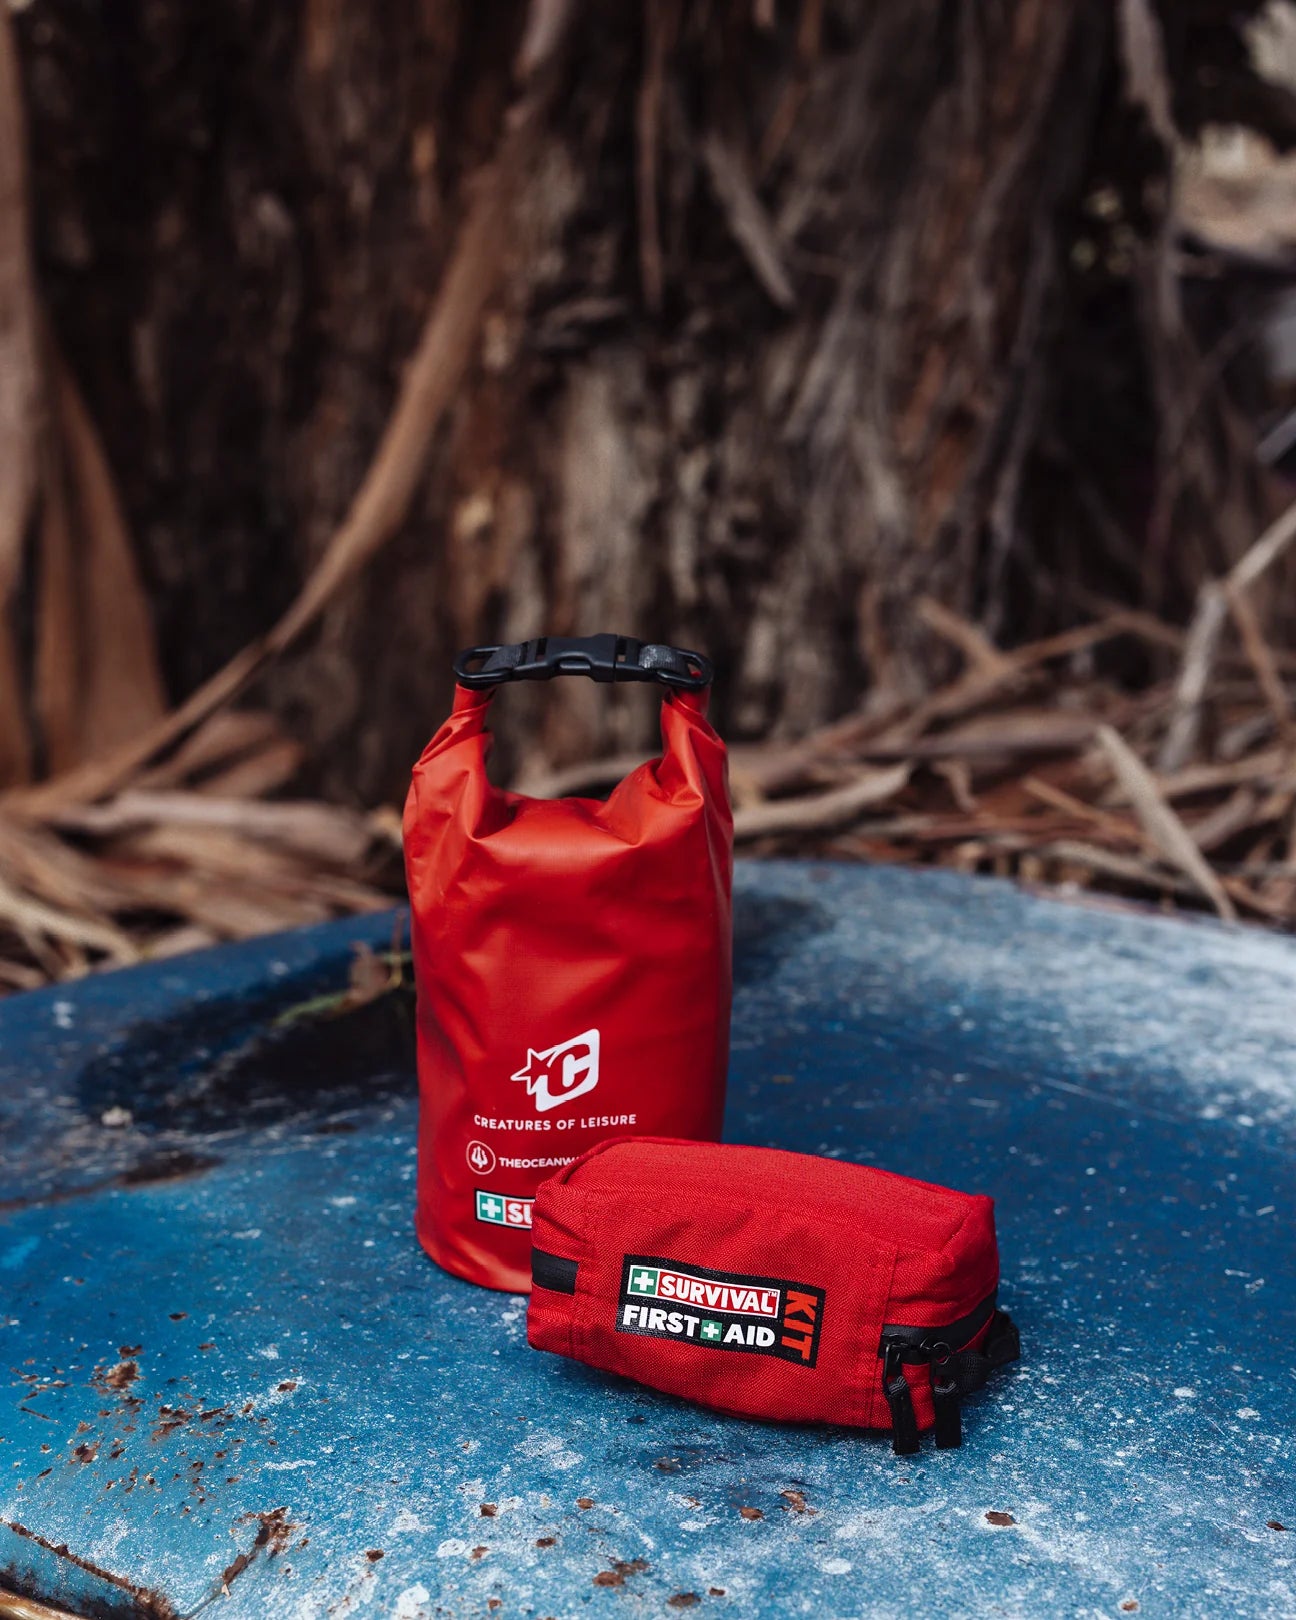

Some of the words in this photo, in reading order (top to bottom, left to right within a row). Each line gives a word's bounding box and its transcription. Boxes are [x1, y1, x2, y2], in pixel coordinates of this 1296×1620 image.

[474, 1114, 551, 1131] CREATURES
[556, 1119, 576, 1130] OF
[581, 1114, 637, 1129] LEISURE
[499, 1156, 579, 1168] THEOCEANW
[622, 1304, 700, 1337] FIRST
[723, 1324, 776, 1347] AID
[781, 1289, 818, 1360] KIT
